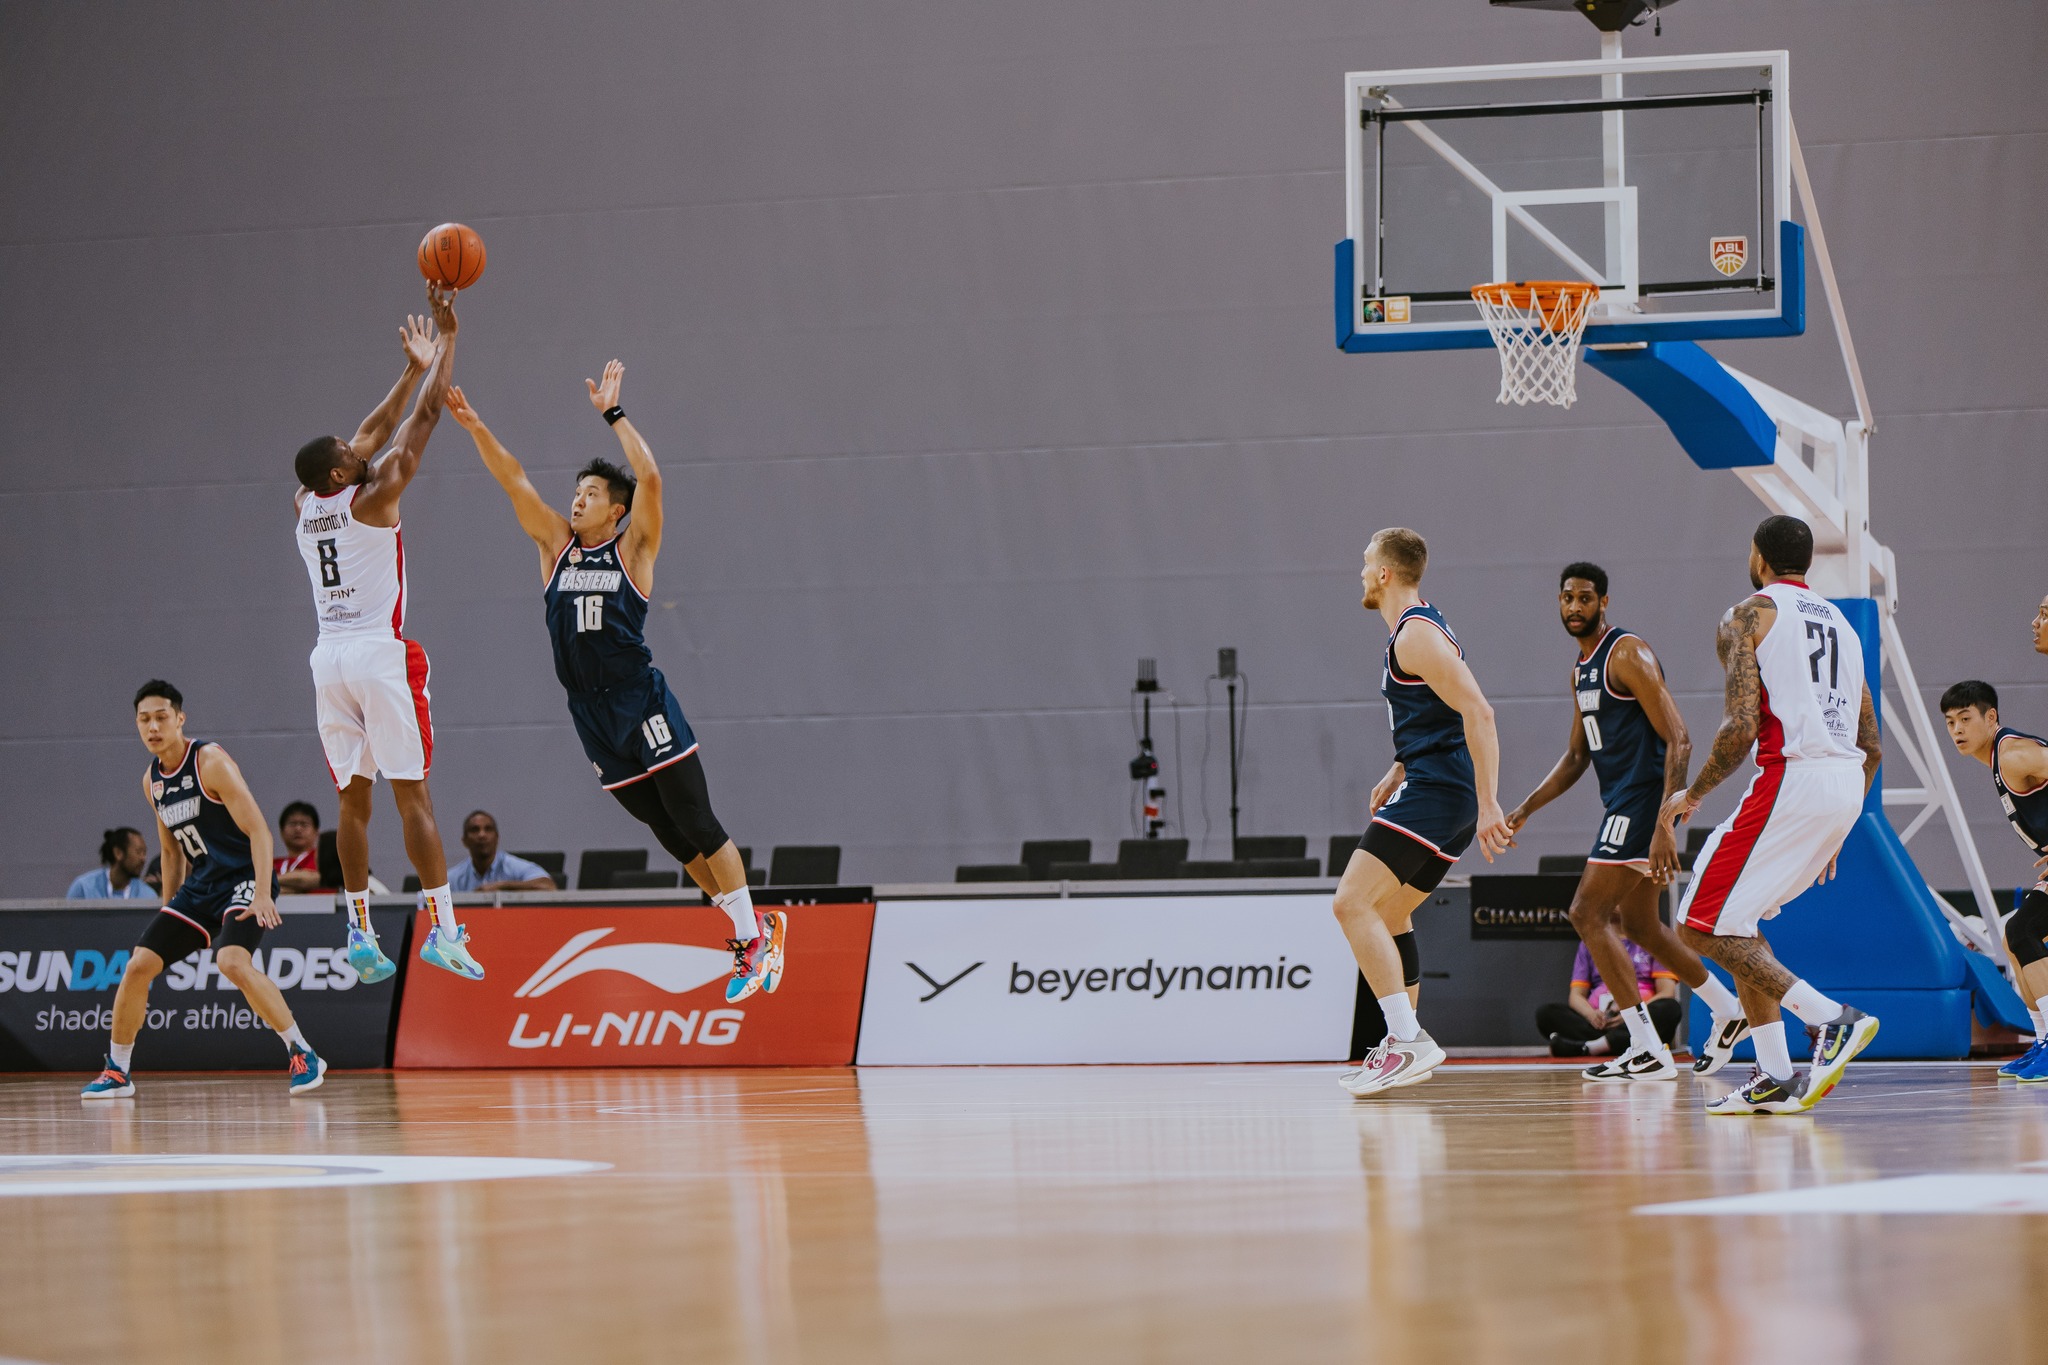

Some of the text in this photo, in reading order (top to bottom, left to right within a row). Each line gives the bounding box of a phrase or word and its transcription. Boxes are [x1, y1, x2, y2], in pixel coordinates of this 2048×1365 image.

[1715, 242, 1744, 255] ABL
[317, 538, 342, 587] 8
[330, 587, 356, 601] FIN+
[558, 570, 622, 592] EASTERN
[573, 595, 604, 632] 16
[641, 714, 672, 749] 16
[1600, 814, 1631, 846] 10
[0, 949, 153, 993] SUNDA
[1008, 956, 1313, 1002] beyerdynamic
[35, 1002, 293, 1031] shade or athlet
[508, 1009, 746, 1048] LI-NING
